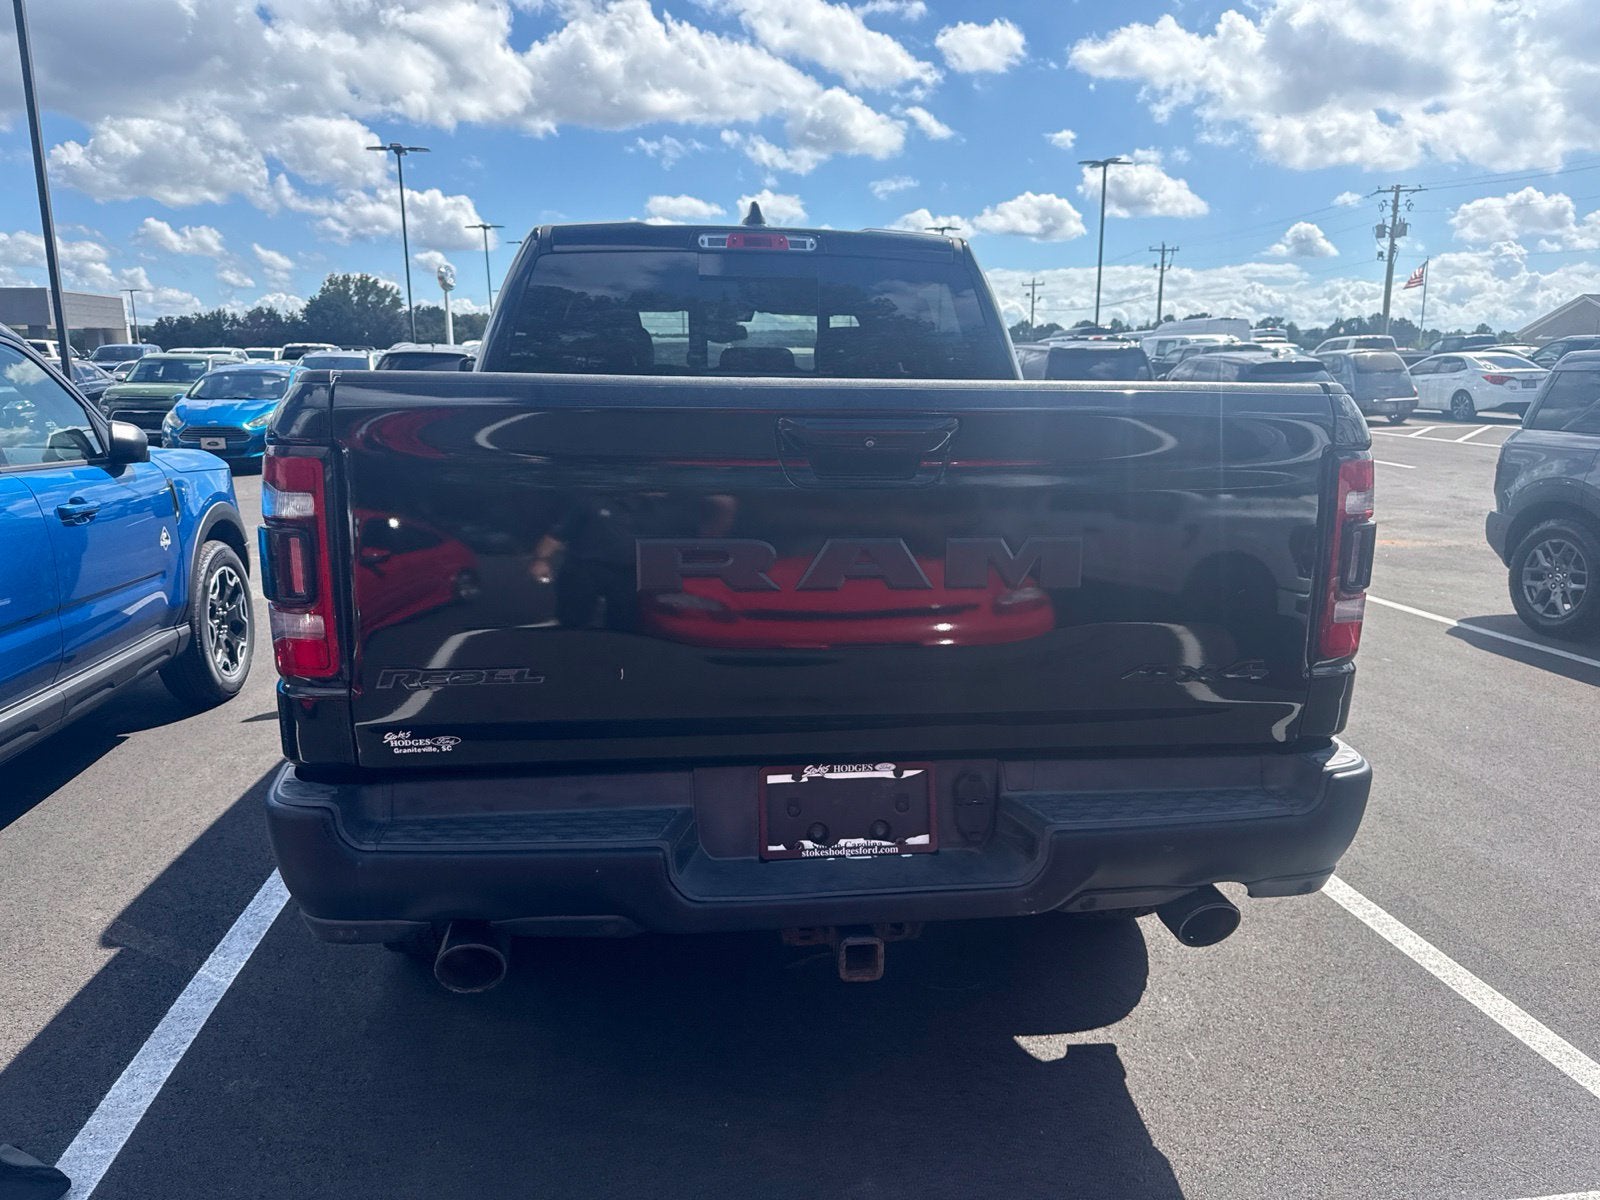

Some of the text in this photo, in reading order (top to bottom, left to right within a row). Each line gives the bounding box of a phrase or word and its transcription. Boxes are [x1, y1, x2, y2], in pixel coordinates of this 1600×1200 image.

[635, 536, 1083, 592] RAM
[376, 668, 545, 690] REBEL
[390, 739, 431, 747] HODGES
[393, 746, 440, 754] Graniteville,
[834, 764, 873, 772] HODGES
[801, 846, 899, 857] stokeshodgesford.com
